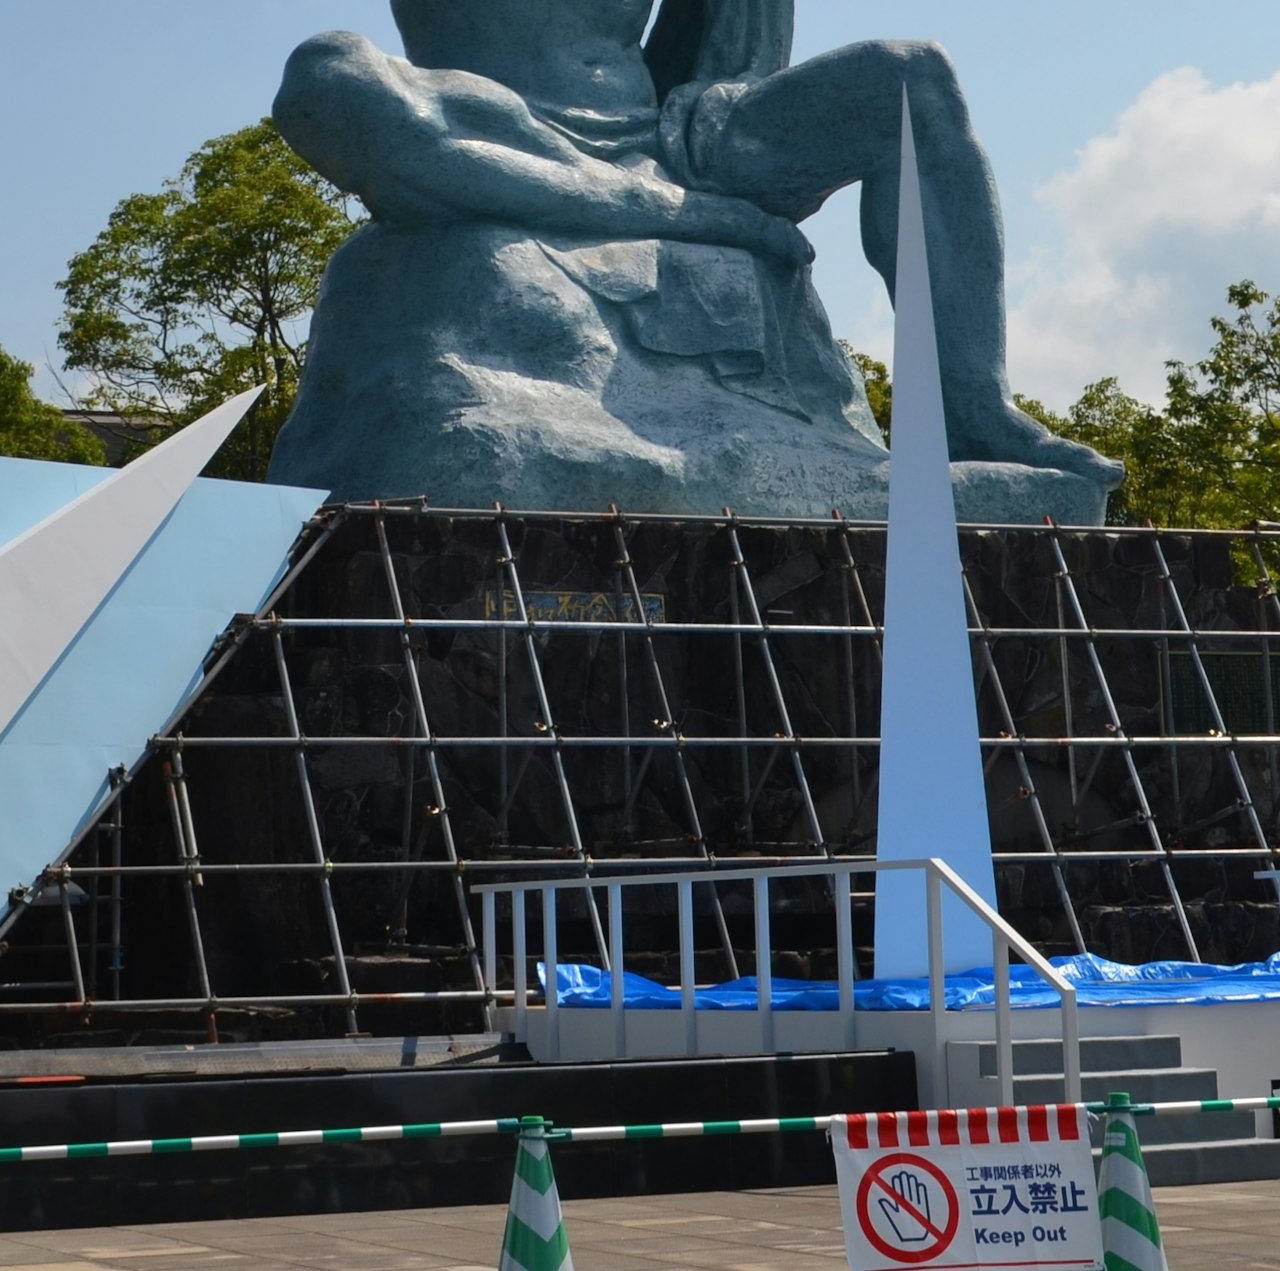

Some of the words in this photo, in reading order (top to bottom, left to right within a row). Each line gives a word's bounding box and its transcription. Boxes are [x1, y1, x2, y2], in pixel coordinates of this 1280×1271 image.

[966, 1163, 1062, 1181] 工事関係者以外
[970, 1181, 1089, 1216] 立入禁止
[974, 1228, 1026, 1247] Keep
[1032, 1226, 1067, 1242] Out
